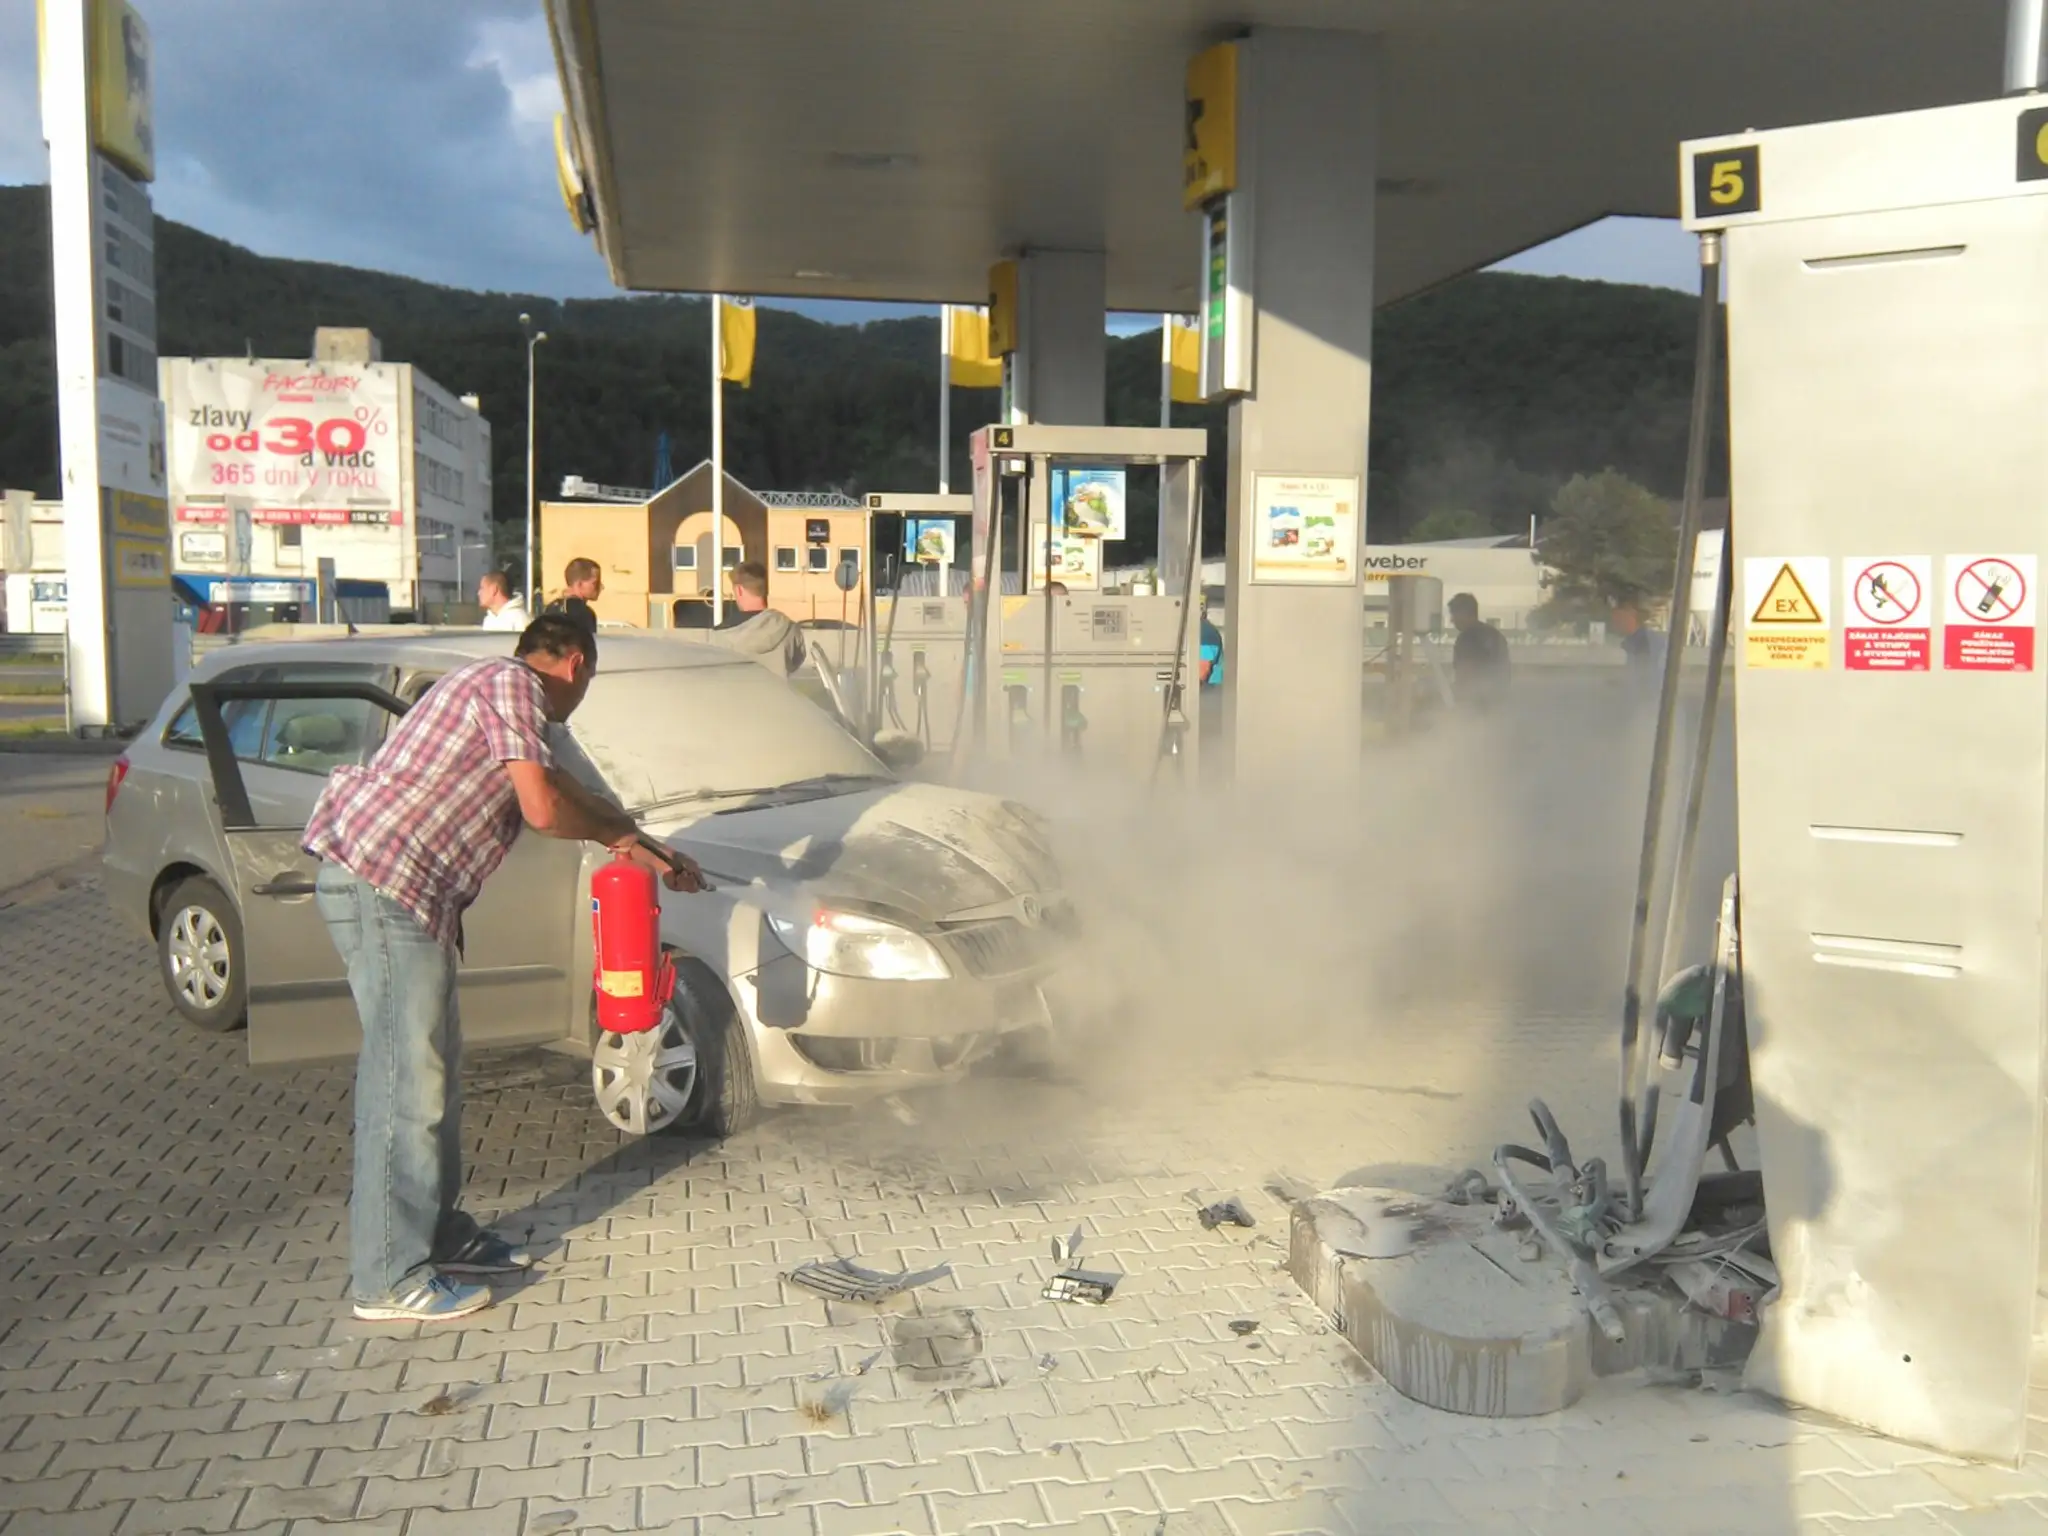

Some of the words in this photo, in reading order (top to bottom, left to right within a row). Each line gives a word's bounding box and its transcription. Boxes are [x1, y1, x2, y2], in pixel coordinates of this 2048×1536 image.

[1709, 159, 1745, 205] 5
[262, 373, 362, 391] FACTORY
[190, 405, 252, 431] zľavy
[206, 430, 260, 452] od
[998, 431, 1009, 445] 4
[300, 448, 313, 467] a
[211, 464, 255, 485] 365
[327, 466, 377, 488] roku
[1364, 553, 1428, 569] weber
[1776, 599, 1798, 613] EX
